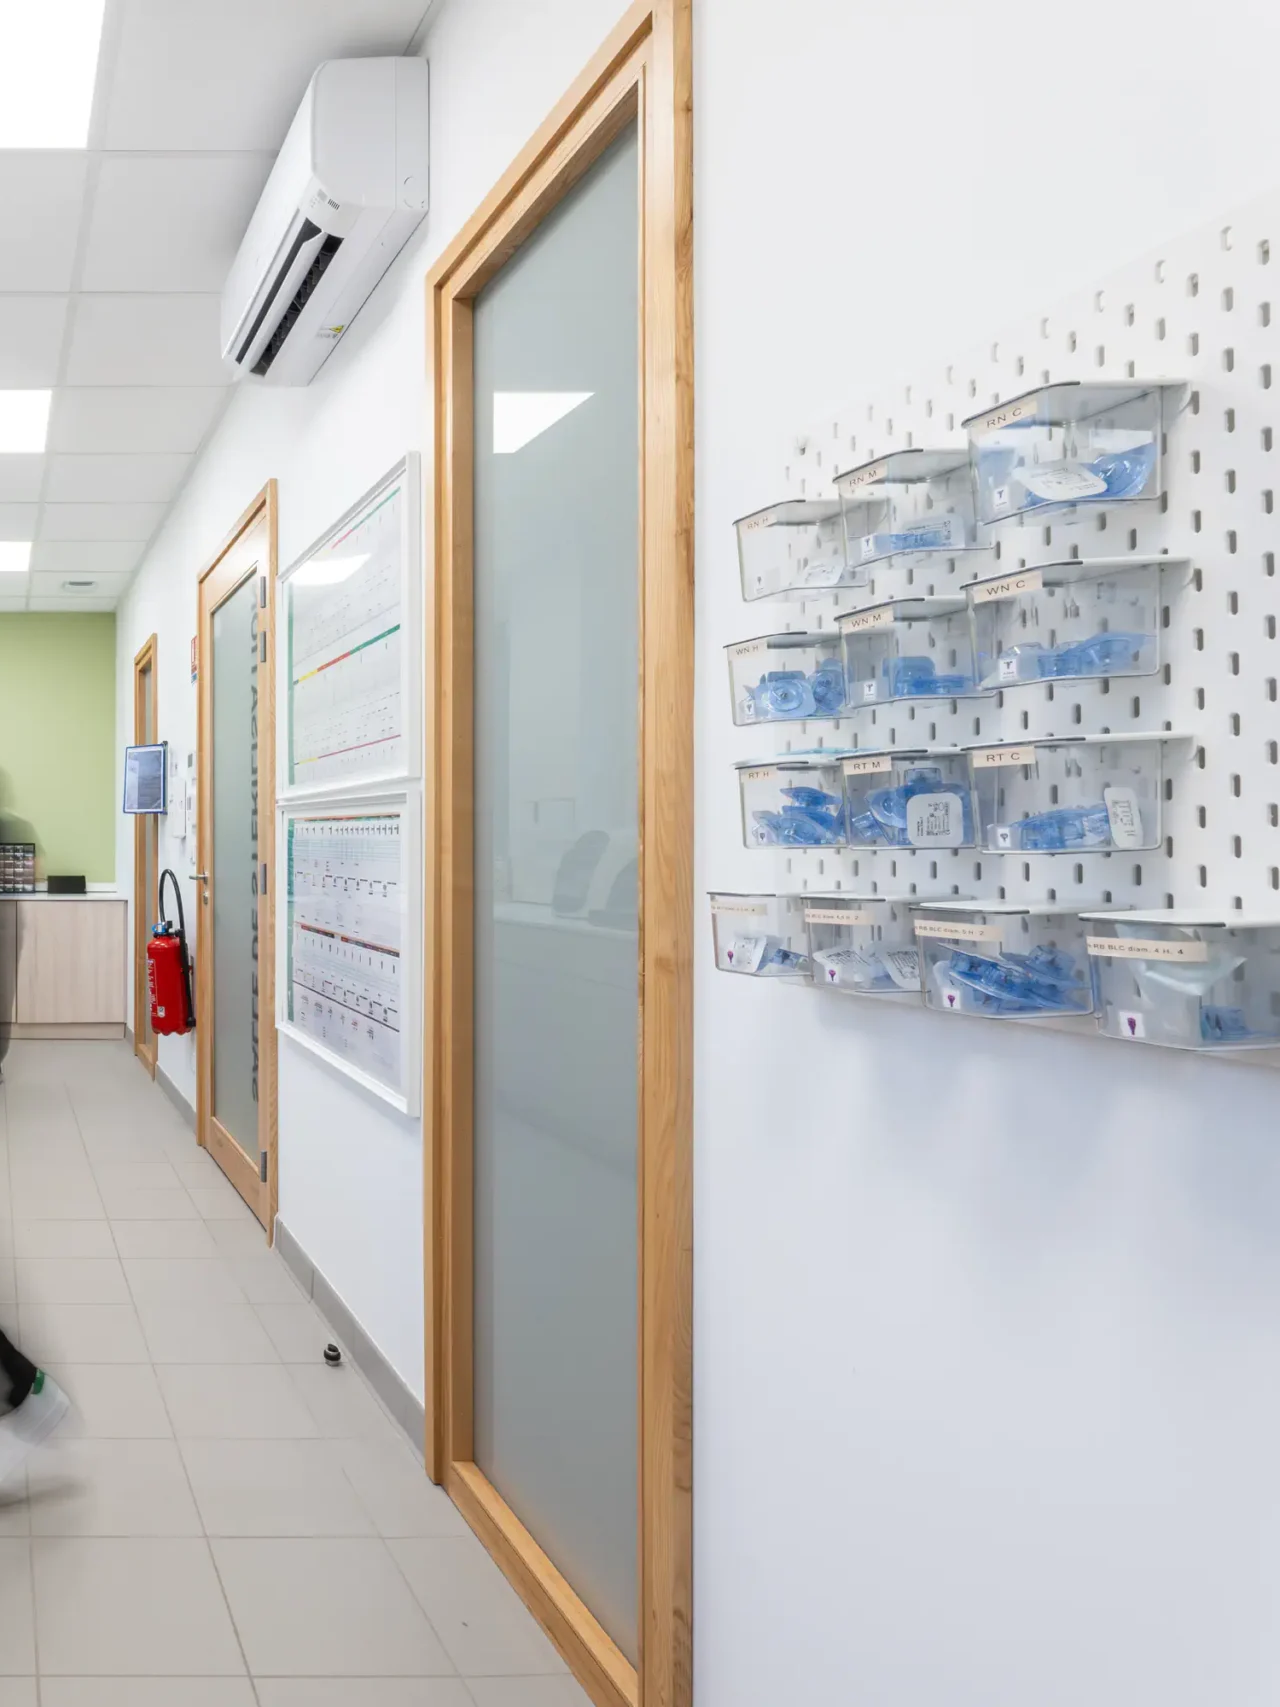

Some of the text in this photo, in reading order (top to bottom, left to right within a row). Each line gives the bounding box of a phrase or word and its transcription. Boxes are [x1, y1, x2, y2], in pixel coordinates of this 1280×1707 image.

[986, 407, 1023, 429] RN C
[849, 469, 879, 488] RN M
[747, 520, 761, 530] RN
[986, 579, 1026, 596] WN C
[851, 613, 882, 628] WN M
[735, 647, 750, 656] WN
[985, 751, 1021, 763] RT C
[853, 760, 881, 771] RT M
